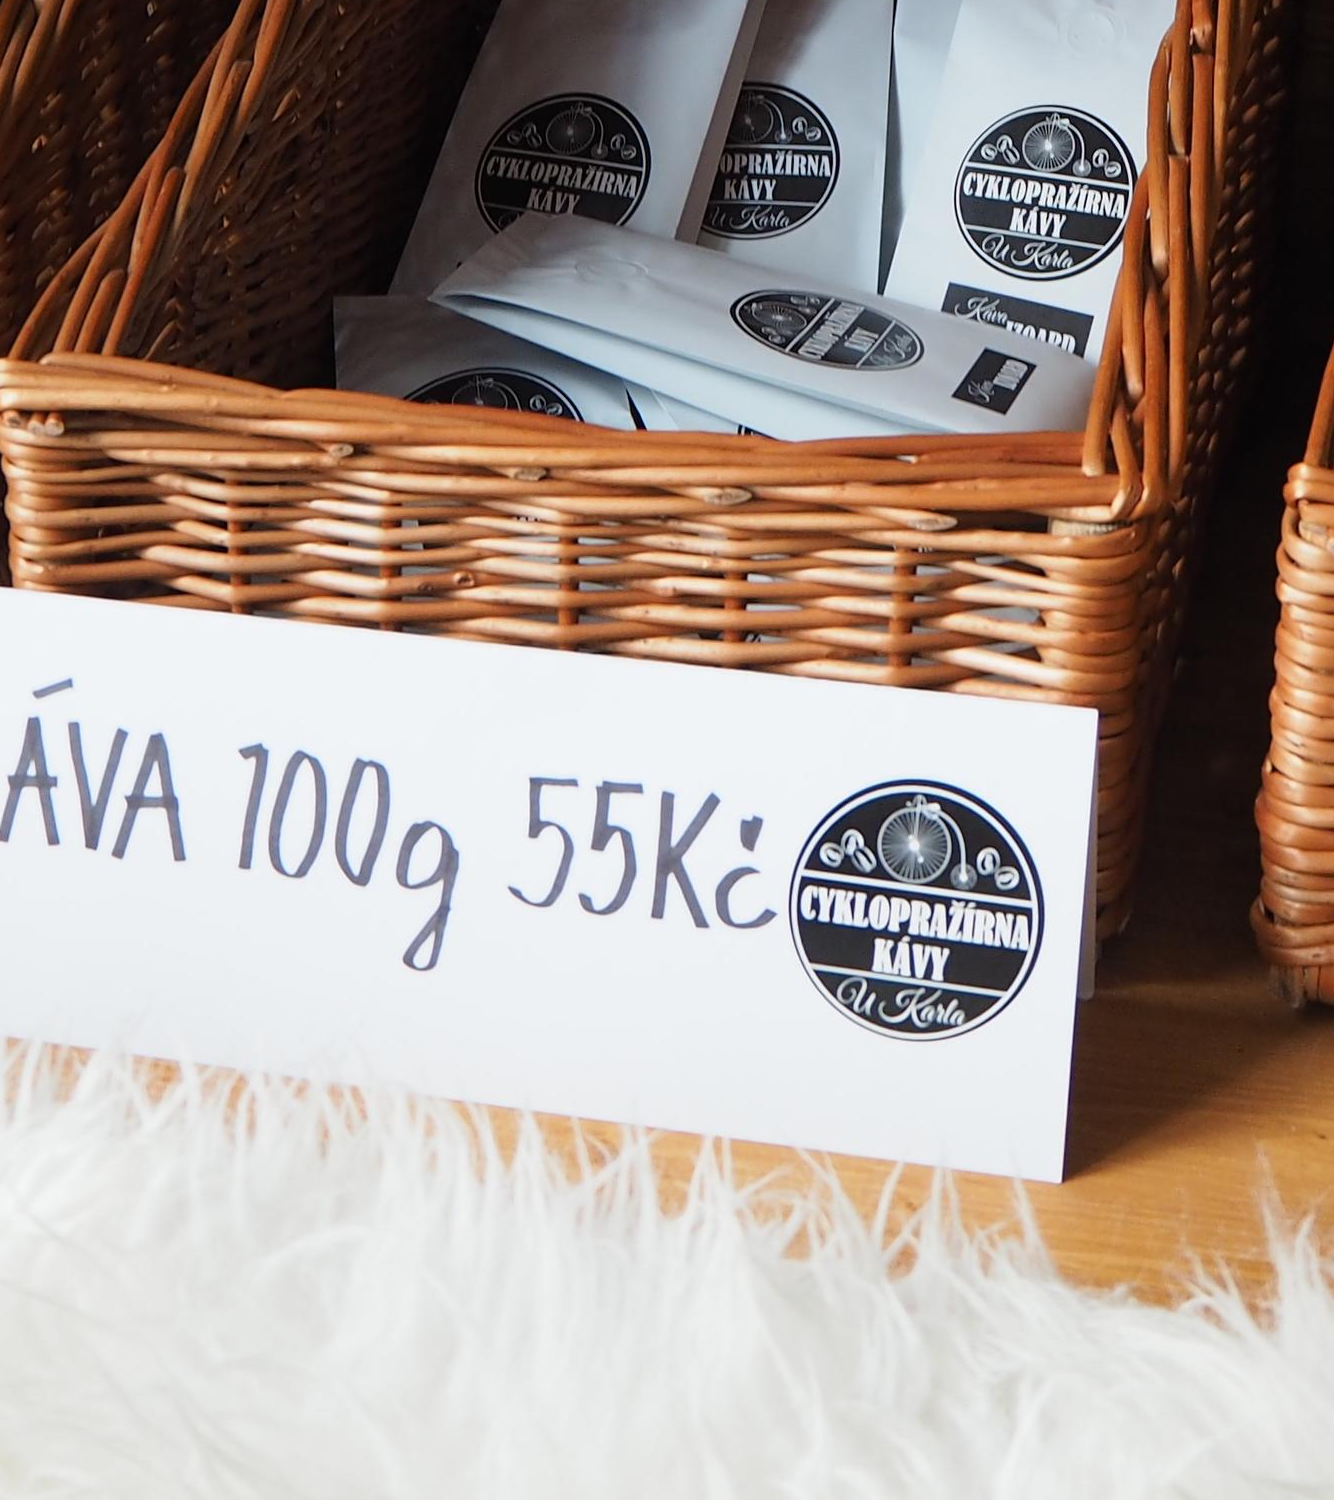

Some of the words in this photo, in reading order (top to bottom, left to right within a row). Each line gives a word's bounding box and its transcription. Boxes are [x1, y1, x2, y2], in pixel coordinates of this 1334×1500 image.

[486, 155, 638, 199] CYKLOPRAŽÍRNA
[719, 150, 832, 178] OPRAŽÍRNA
[526, 186, 581, 215] KÁVY
[723, 175, 777, 201] KÁVY
[962, 171, 1126, 220] CYKLOPRAŽÍRNA
[729, 205, 791, 231] Karla
[1008, 206, 1067, 239] KÁVY
[981, 233, 1010, 262] U
[1010, 241, 1074, 271] Karla
[238, 742, 461, 973] 100g
[507, 777, 779, 930] 55Kč
[799, 883, 1030, 951] CYKLOPRAŽÍRNA
[871, 935, 951, 982] KÁVY
[836, 976, 878, 1017] U
[877, 987, 967, 1029] Karla
